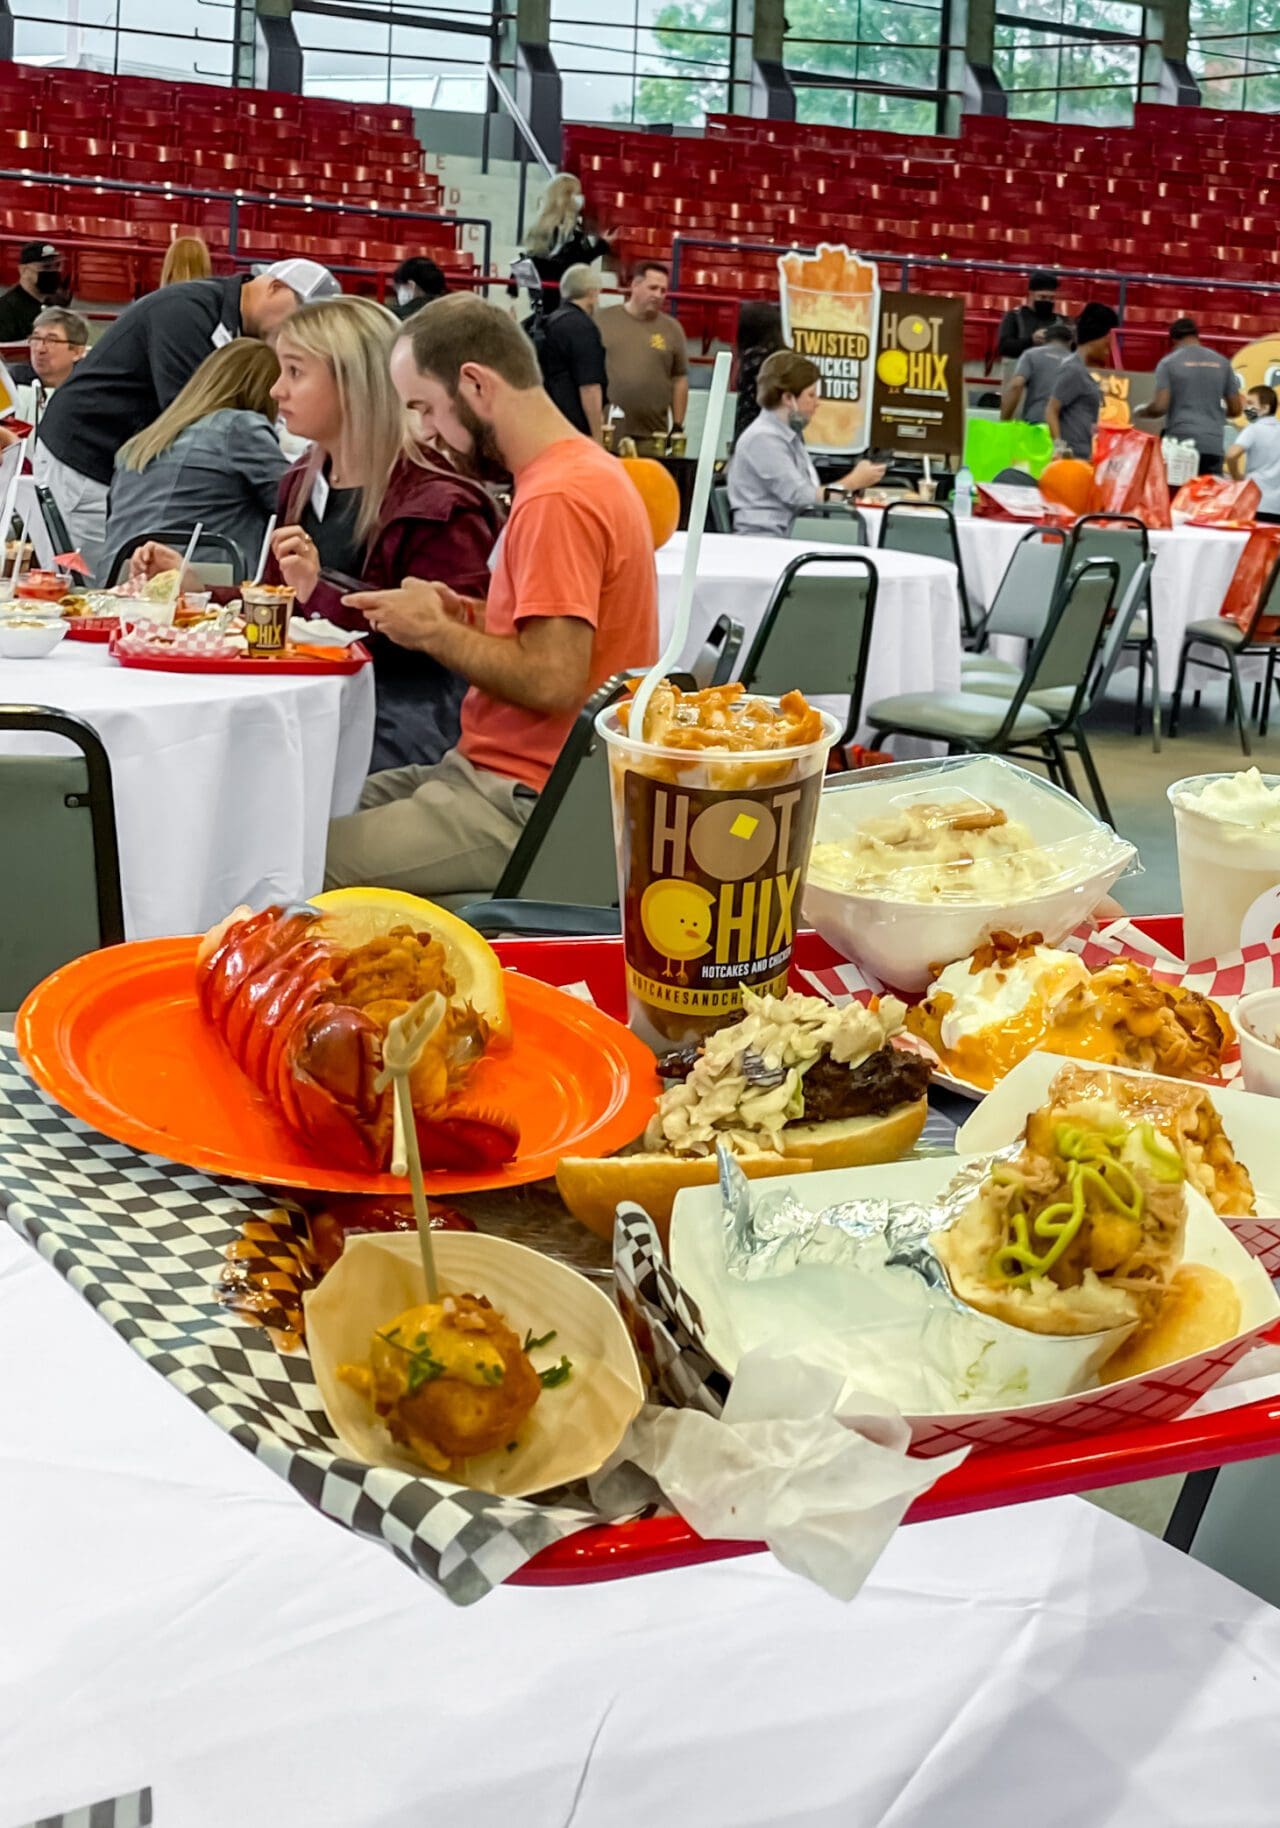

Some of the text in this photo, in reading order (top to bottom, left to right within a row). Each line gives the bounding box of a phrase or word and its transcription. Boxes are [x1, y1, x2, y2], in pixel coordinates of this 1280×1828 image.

[449, 188, 460, 205] D
[793, 329, 868, 358] TWISTED
[881, 312, 944, 354] HOT
[824, 378, 859, 400] TOTS
[651, 788, 802, 882] HOT
[640, 866, 802, 964] CHIX
[701, 962, 750, 978] HOTCAKES
[751, 958, 767, 974] AND
